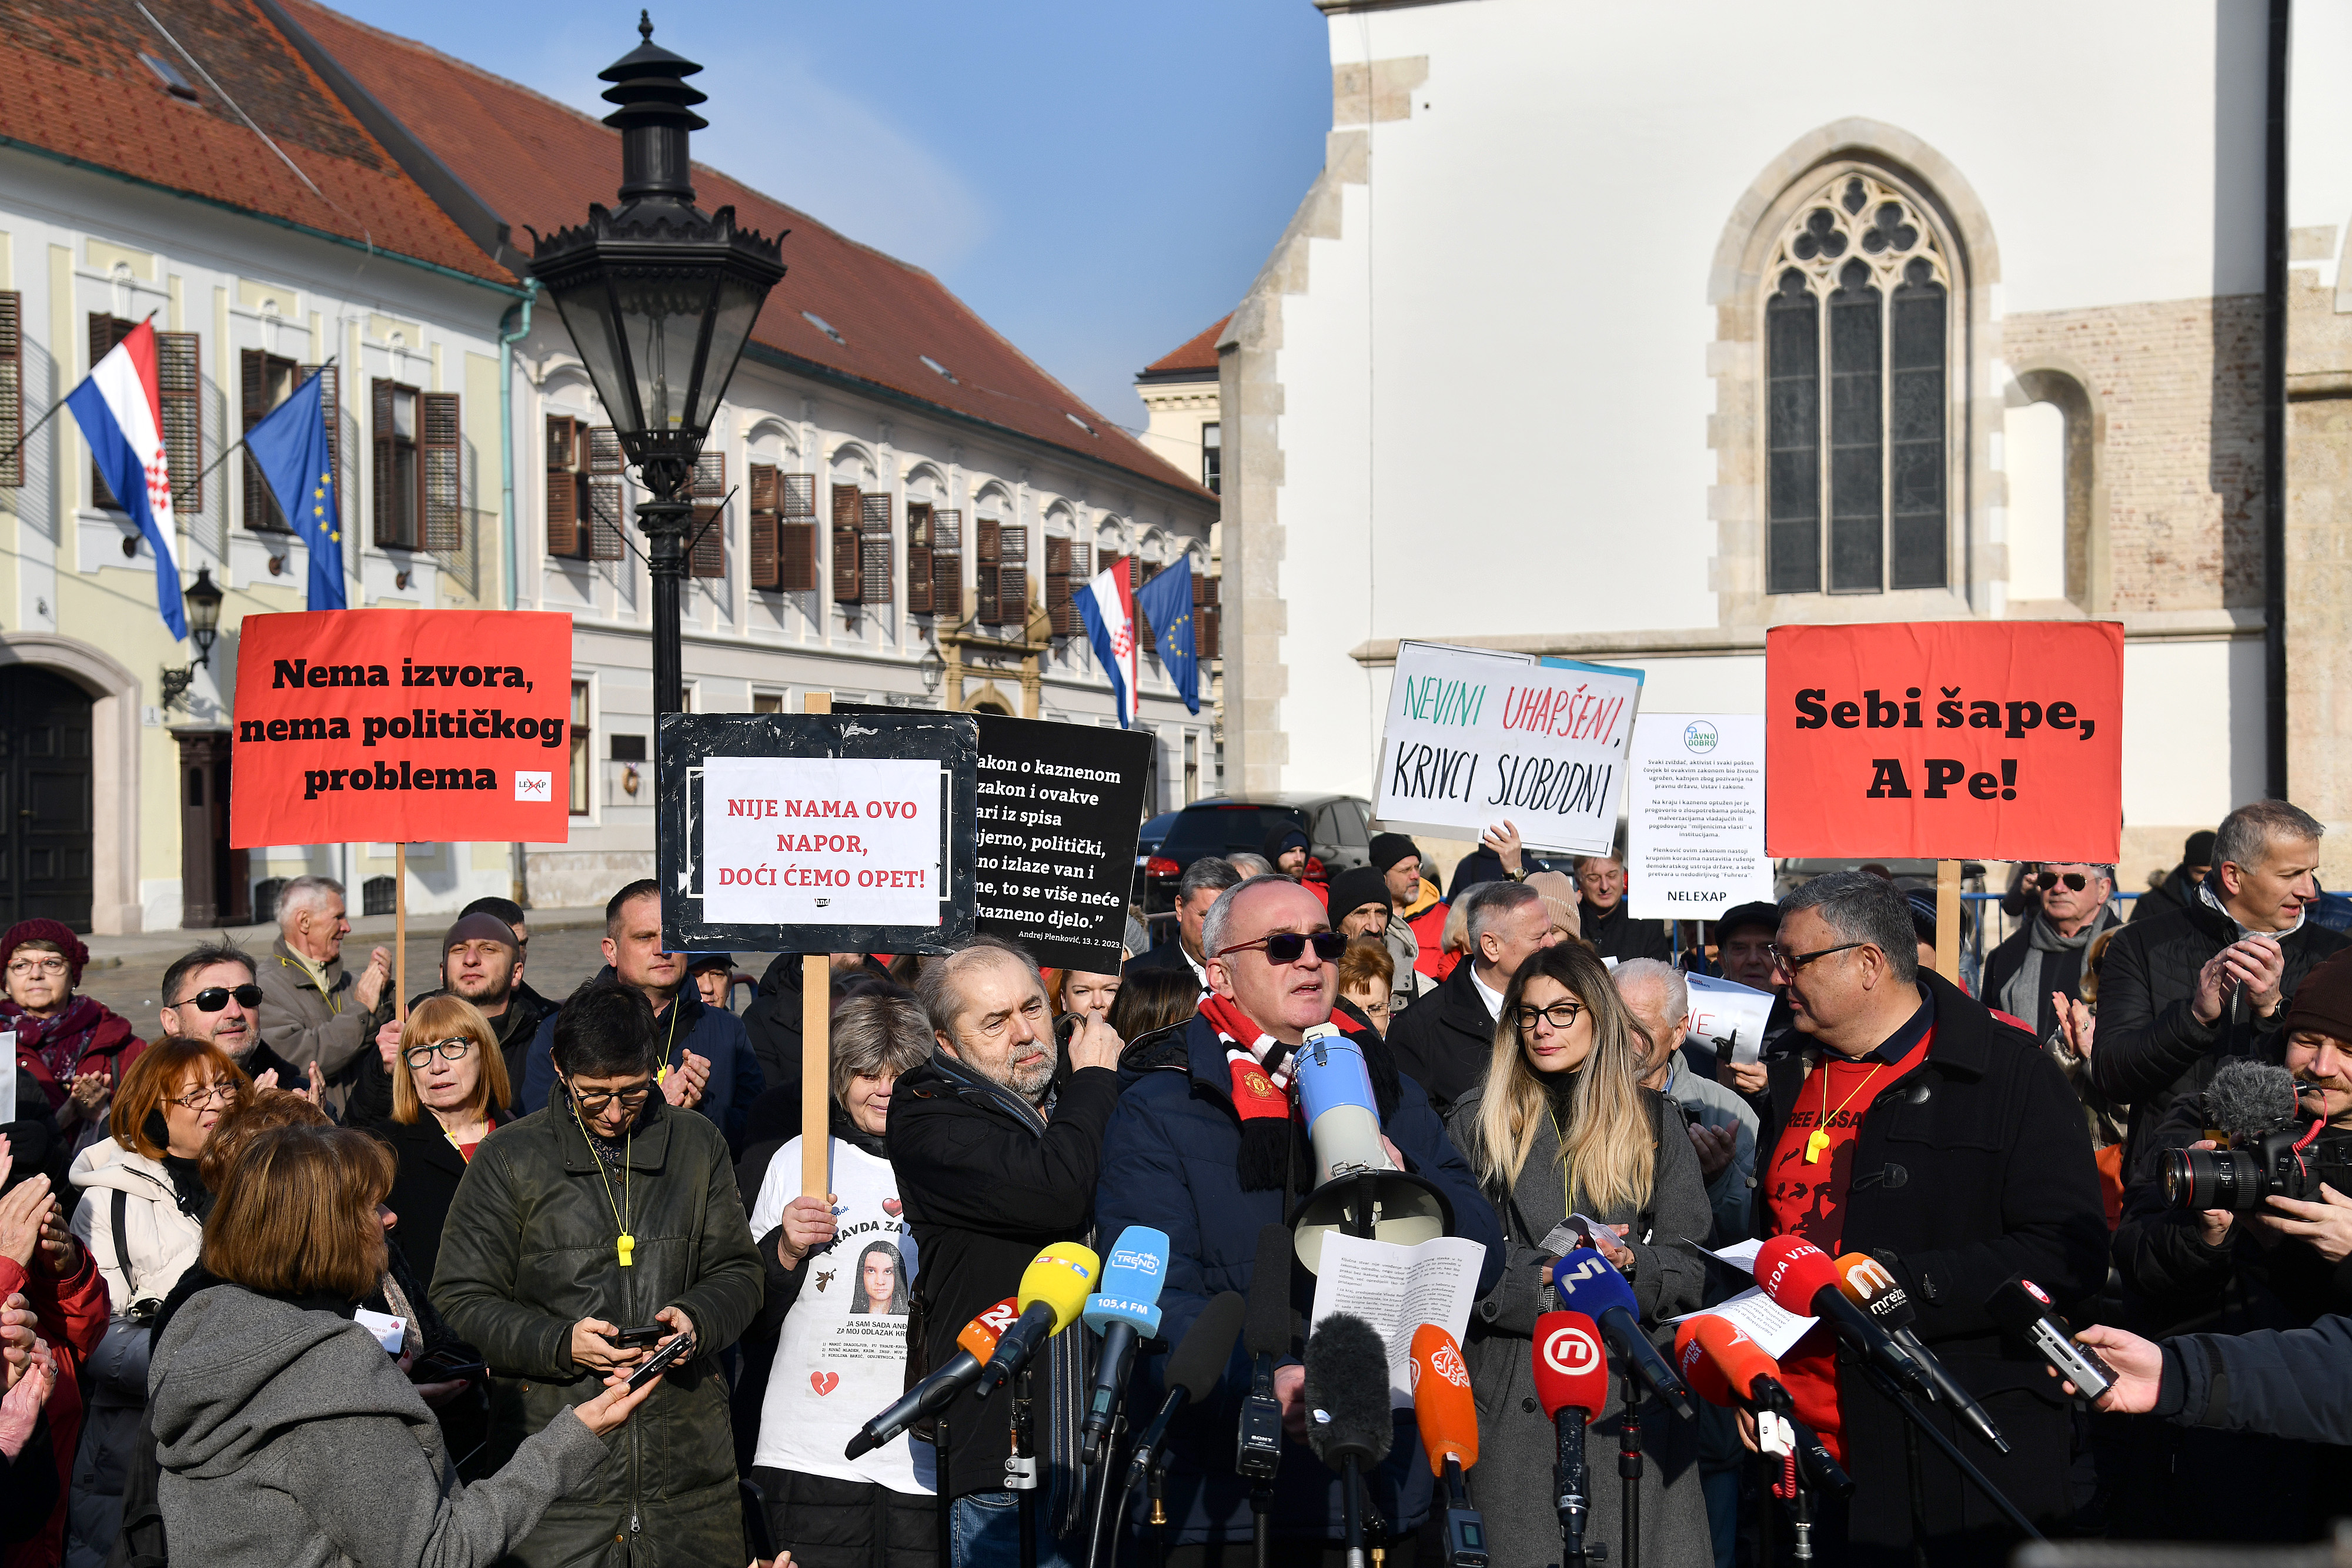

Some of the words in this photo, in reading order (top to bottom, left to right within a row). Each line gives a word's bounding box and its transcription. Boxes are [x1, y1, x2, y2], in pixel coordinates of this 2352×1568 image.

[272, 658, 389, 689] Nema
[402, 657, 533, 693] izvora,
[1404, 675, 1486, 726] NEVINI
[1502, 683, 1624, 748] UHAPŠENI,
[1795, 687, 1923, 729] Sebi
[1937, 686, 2094, 740] šape,
[239, 717, 350, 743] nema
[362, 708, 564, 748] političkog
[1688, 731, 1715, 739] JAVNO
[303, 760, 497, 800] problema
[977, 754, 1017, 771] akon
[1021, 761, 1030, 773] o
[1034, 759, 1120, 783] kaznenom
[1392, 741, 1478, 803] KRIVCI
[1488, 753, 1612, 818] SLOBODNI
[1866, 758, 1912, 798] A
[1924, 758, 2017, 800] Pe!
[977, 780, 1025, 798] zakon
[1029, 783, 1035, 798] i
[1039, 788, 1098, 805] ovakve
[727, 799, 777, 820] NIJE
[784, 800, 859, 818] NAMA
[866, 801, 917, 818] OVO
[1001, 805, 1016, 821] iz
[1020, 809, 1061, 827] spisa
[777, 834, 867, 856] NAPOR,
[976, 828, 1026, 850] jerno,
[1030, 835, 1105, 858] politički,
[719, 863, 776, 885] DOĆI
[784, 863, 850, 887] ĆEMO
[857, 870, 924, 888] OPET!
[976, 857, 998, 868] no
[1001, 855, 1050, 874] izlaze
[1053, 864, 1084, 878] van
[1087, 864, 1094, 879] i
[1002, 881, 1018, 895] to
[1022, 886, 1040, 897] se
[1044, 885, 1077, 902] više
[1080, 891, 1120, 907] neće
[1668, 891, 1726, 901] NELEXAP
[976, 902, 1044, 922] kazneno
[1018, 931, 1043, 940] Andrej
[1044, 932, 1080, 944] Plenković,
[1101, 940, 1121, 948] 2023.
[884, 1221, 903, 1233] ZA
[1036, 1256, 1085, 1276] RTL
[1117, 1254, 1156, 1269] TREND
[1768, 1261, 1789, 1298] VIDA
[1098, 1298, 1128, 1309] 105,4
[1130, 1302, 1148, 1315] FM
[1870, 1288, 1906, 1315] mreža
[1690, 1346, 1702, 1364] list
[1251, 1435, 1273, 1443] SONY
